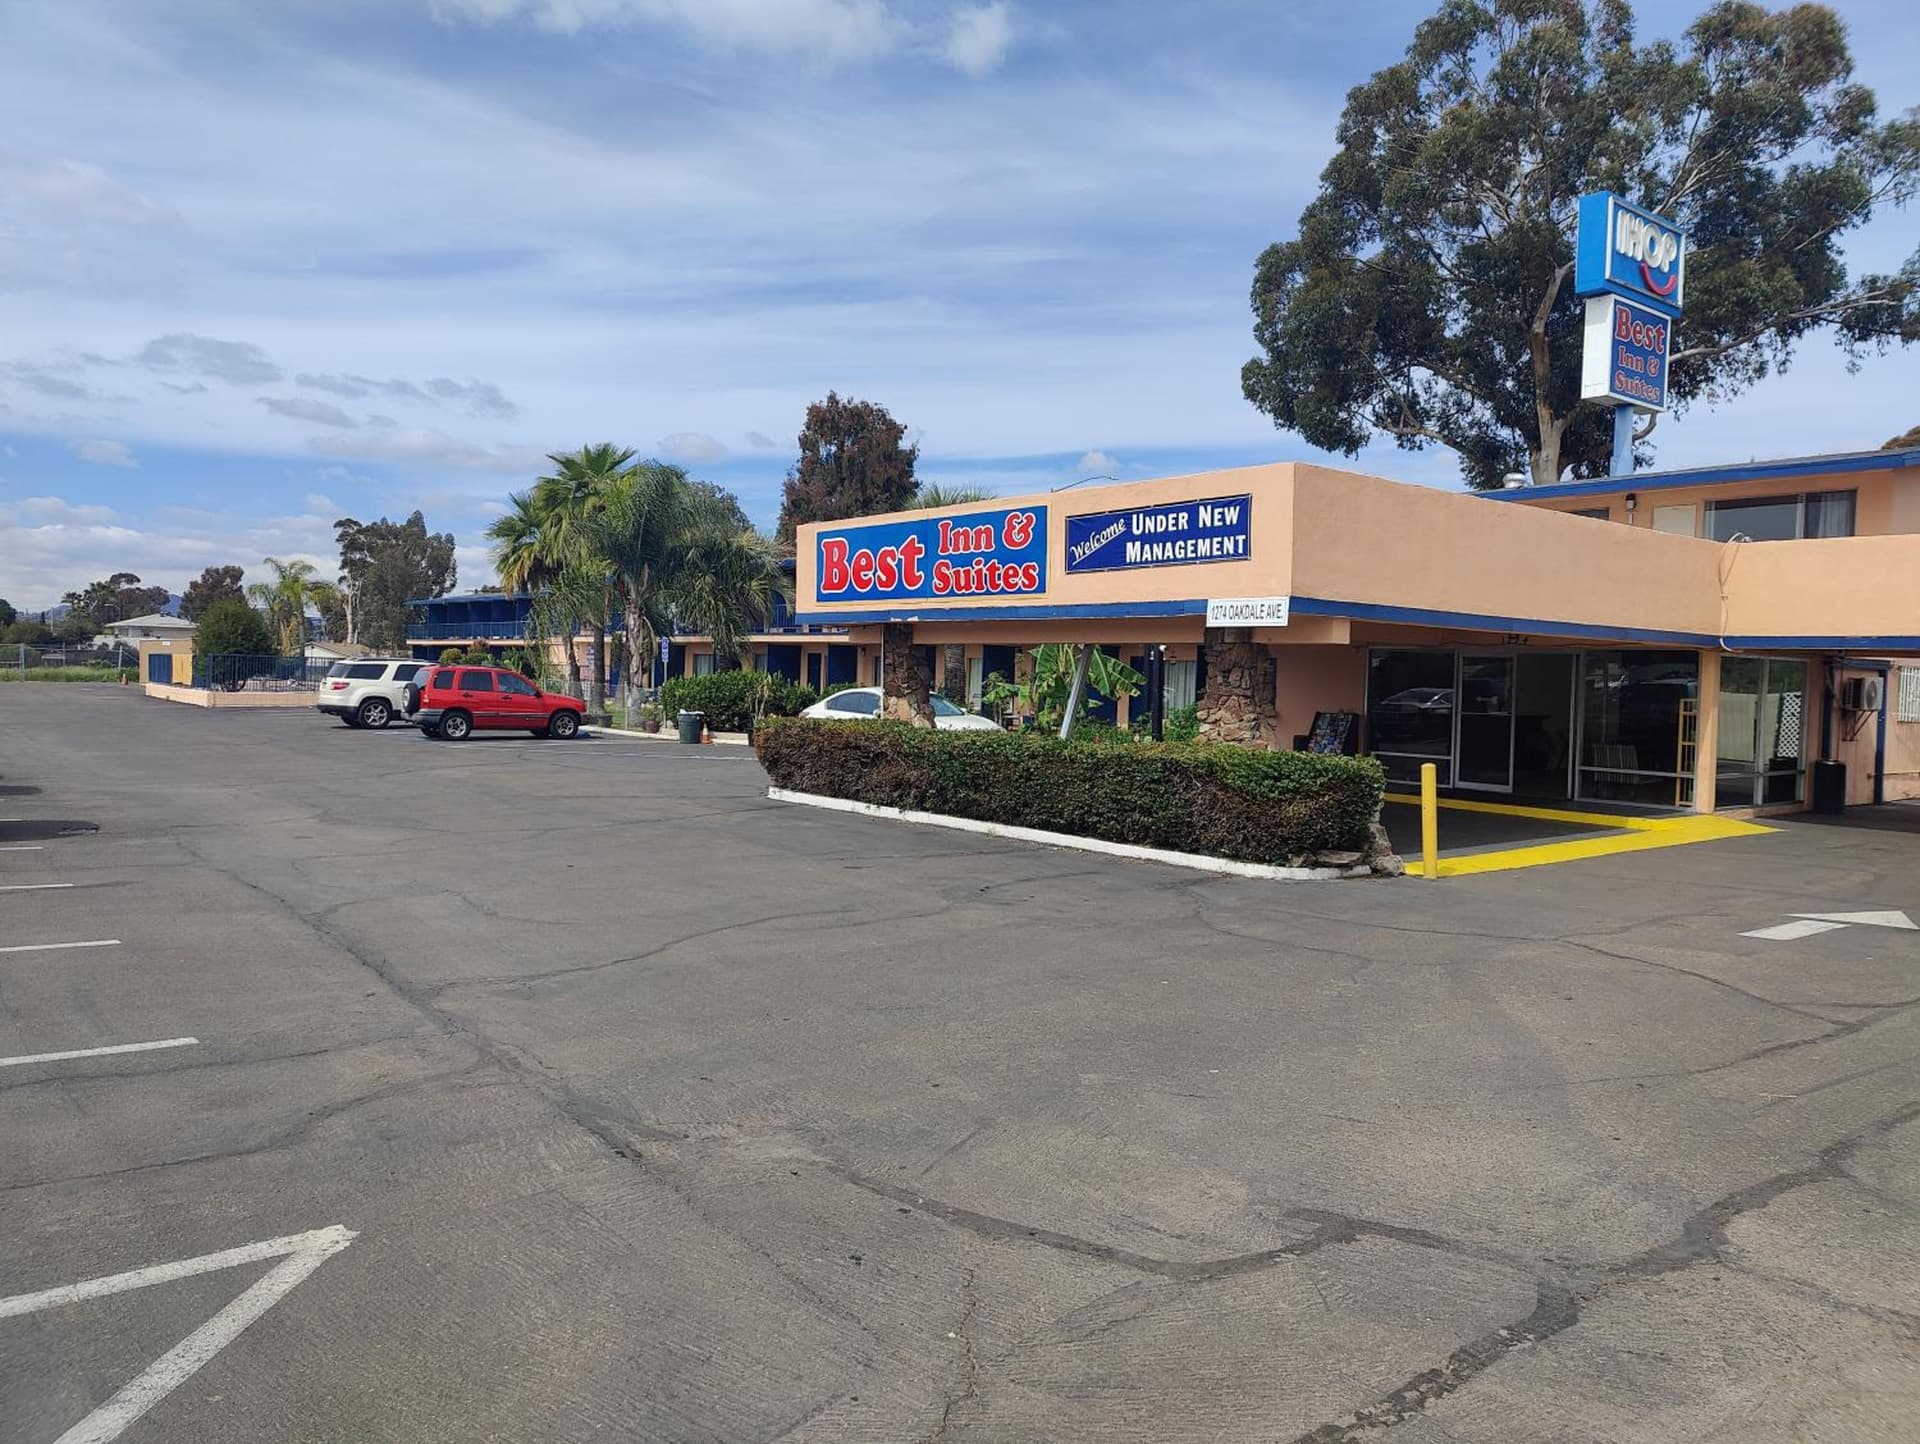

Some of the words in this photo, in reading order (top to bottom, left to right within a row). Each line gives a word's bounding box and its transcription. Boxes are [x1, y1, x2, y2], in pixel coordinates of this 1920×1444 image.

[1616, 209, 1677, 273] IHOP
[1615, 306, 1666, 354] Best
[1618, 346, 1645, 372] Inn
[1646, 355, 1660, 376] &
[1615, 370, 1660, 402] Suites
[937, 520, 995, 555] Inn
[1002, 511, 1036, 550] &
[1131, 512, 1189, 535] UNDER
[1198, 504, 1240, 528] NEW
[1070, 518, 1127, 563] Welcome
[1126, 534, 1246, 563] MANAGEMENT
[820, 535, 925, 593] Best
[932, 557, 1039, 595] Suites
[1211, 605, 1227, 620] 1274
[1228, 603, 1265, 620] OAKDALE
